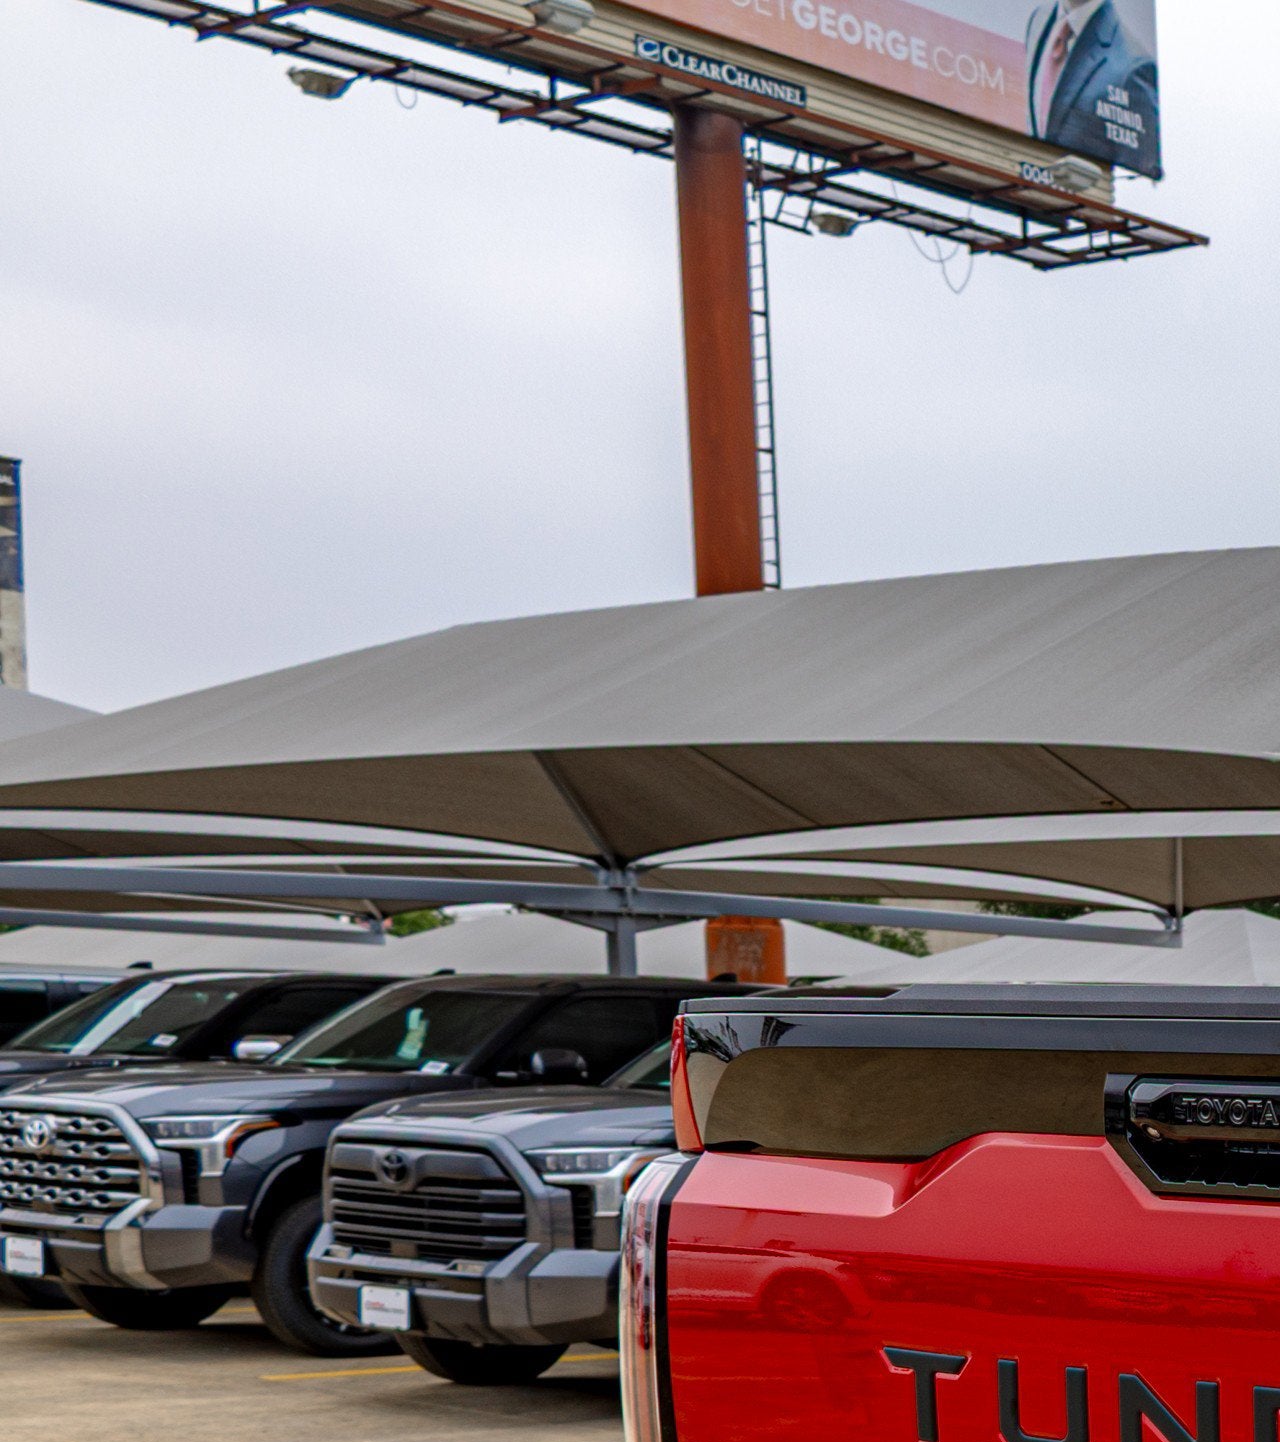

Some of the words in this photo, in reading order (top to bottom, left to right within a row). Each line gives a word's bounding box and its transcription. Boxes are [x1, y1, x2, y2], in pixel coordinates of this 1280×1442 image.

[1107, 84, 1129, 107] SAN
[1096, 100, 1146, 134] ANTONIO,
[1105, 121, 1139, 149] TEXAS
[1182, 1097, 1280, 1127] TOYOTA
